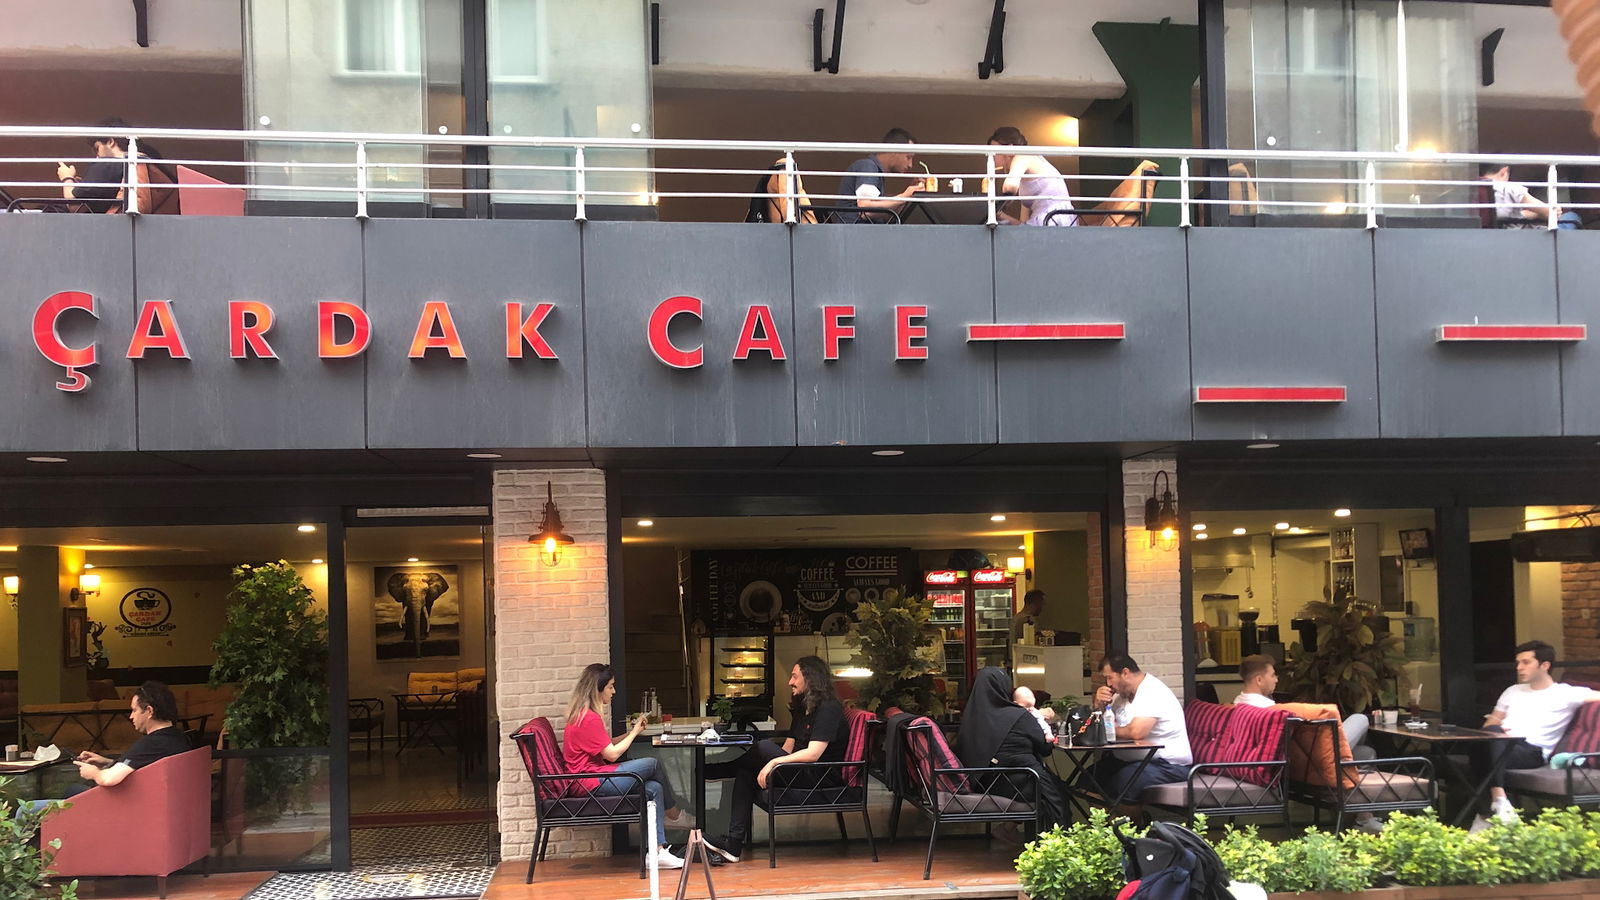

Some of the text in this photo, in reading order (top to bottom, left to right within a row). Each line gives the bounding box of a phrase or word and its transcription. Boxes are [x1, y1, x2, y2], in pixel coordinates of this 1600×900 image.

[32, 290, 929, 392] ÇARDAK CAFE
[846, 556, 897, 569] COFFEE
[800, 567, 835, 581] COFFEE
